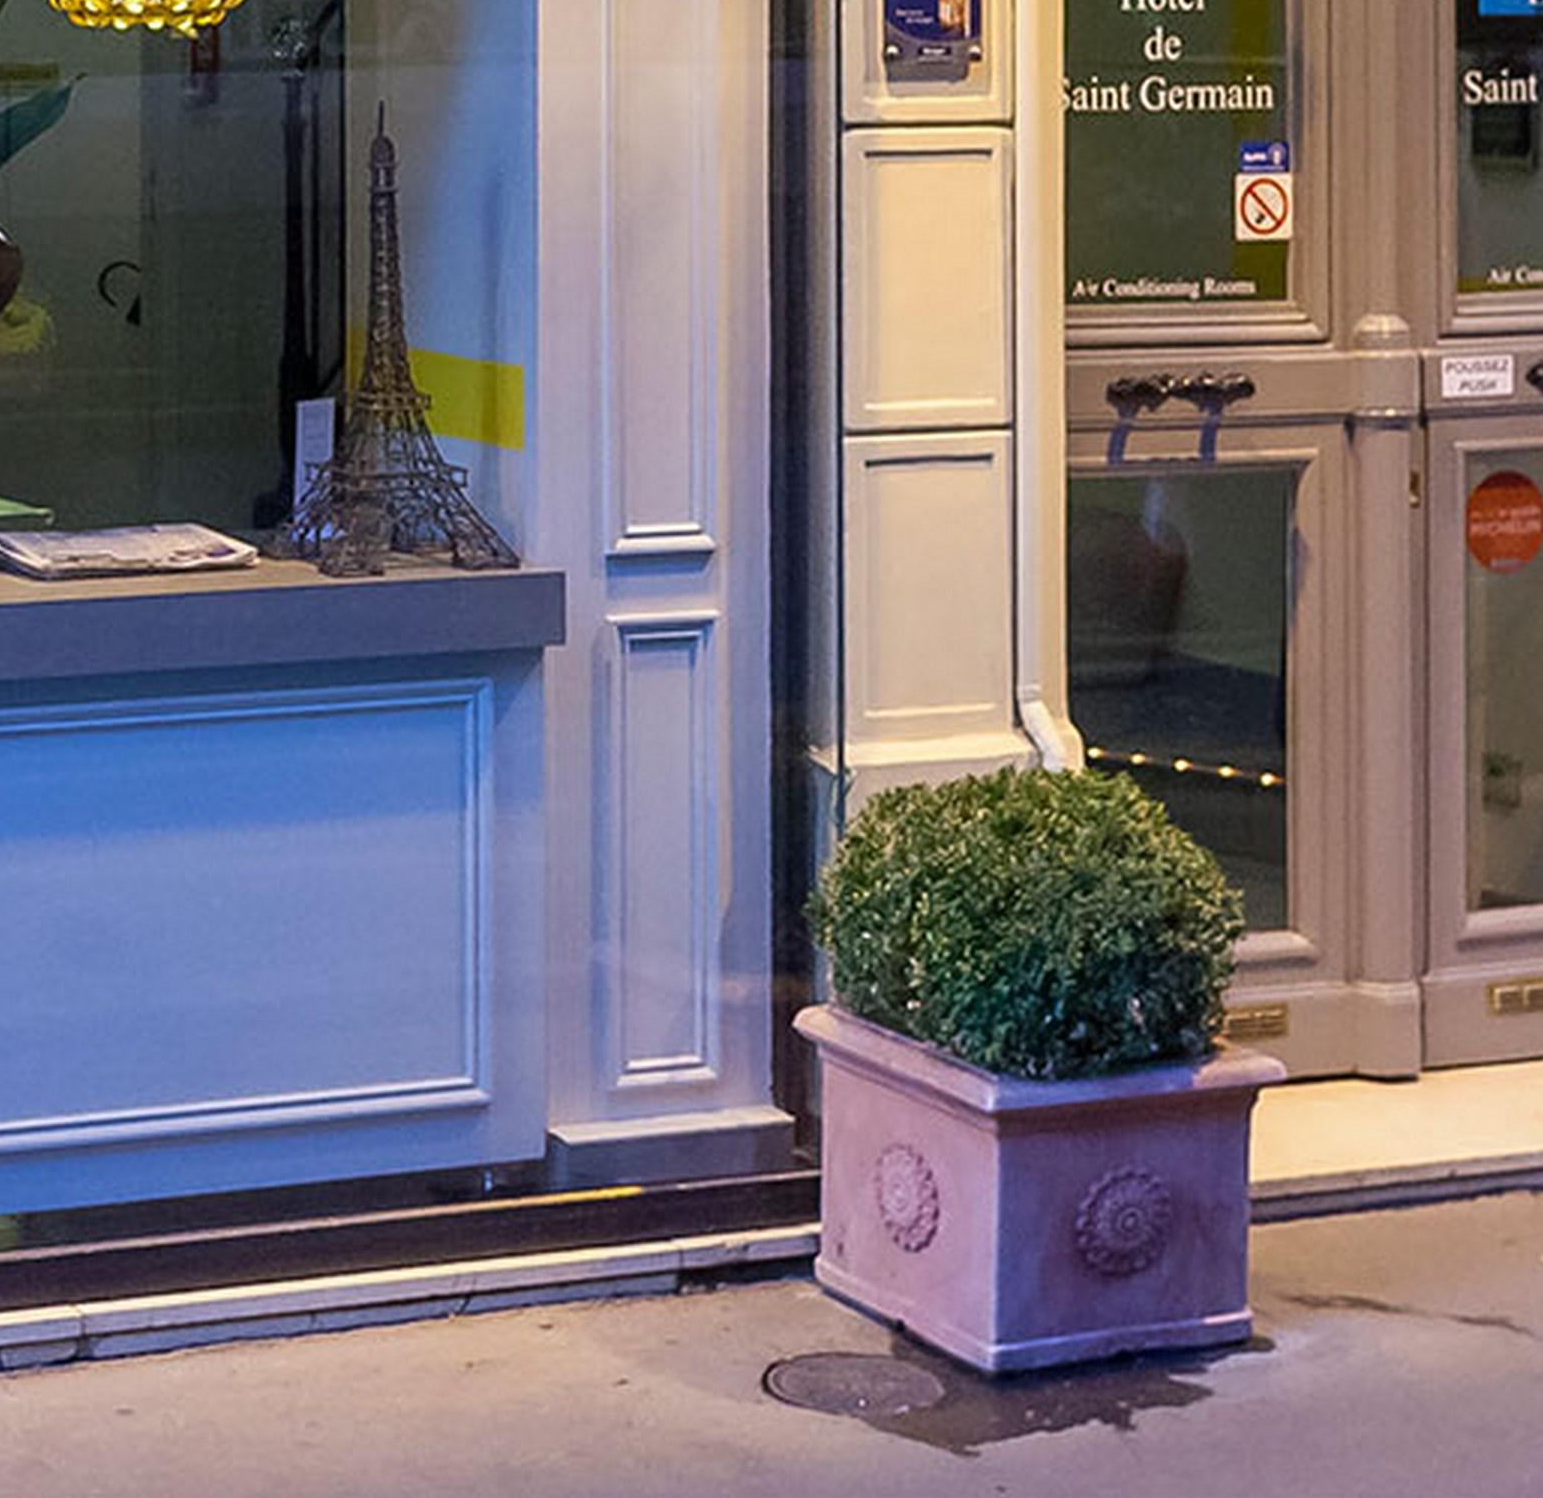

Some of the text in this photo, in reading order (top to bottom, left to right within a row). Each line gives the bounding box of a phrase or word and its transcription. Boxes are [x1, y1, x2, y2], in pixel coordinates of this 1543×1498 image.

[1144, 25, 1182, 61] de
[1139, 74, 1274, 111] Germain
[1463, 68, 1538, 104] Saint
[1103, 277, 1200, 299] Conditioning
[1205, 277, 1256, 295] Rooms
